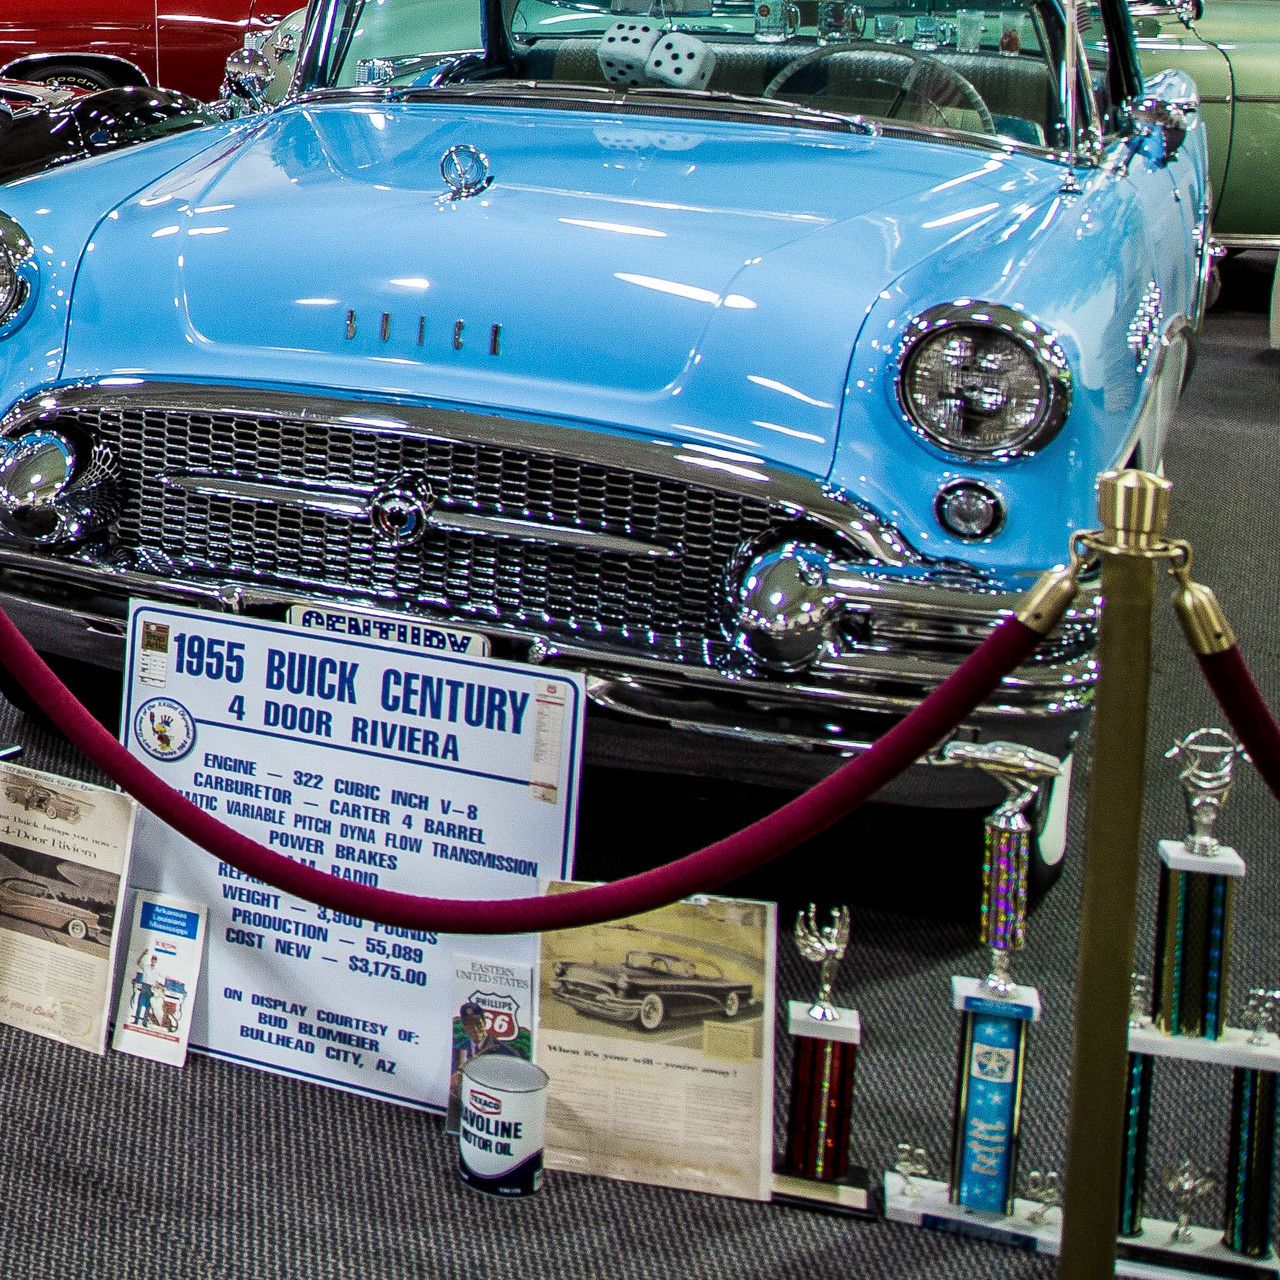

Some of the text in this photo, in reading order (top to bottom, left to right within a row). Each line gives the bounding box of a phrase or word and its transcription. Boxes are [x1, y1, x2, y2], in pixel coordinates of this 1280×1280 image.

[174, 632, 530, 735] 1955 BUICK CENTURY
[228, 694, 460, 762] 4 DOOR RIVIERA
[204, 752, 257, 776] ENGINE
[293, 770, 324, 790] 322
[334, 778, 380, 800] CUBIC
[391, 789, 430, 811] INCH
[13, 814, 40, 829] Buick
[193, 772, 486, 845] CARBURETOR CARTER 4 BARREL
[1, 824, 48, 845] 4-Door
[52, 838, 98, 859] Riviera
[226, 799, 538, 878] VARIABLE PITCH DYNA FLOW TRANSMISSION
[269, 830, 324, 856] POWER
[336, 844, 398, 871] BRAKES
[330, 864, 379, 888] RADIO
[222, 884, 281, 910] WEIGHT
[152, 915, 187, 928] Louisiana
[154, 906, 188, 918] Arkansas
[232, 908, 424, 964] PRODUCTION 55,089
[226, 927, 428, 986] COST NEW $3,175.00
[471, 962, 516, 978] EASTERN
[456, 970, 529, 990] UNITED STATES
[224, 987, 420, 1045] ON DISPLAY COURTESY OF:
[476, 996, 513, 1012] PHILLIPS
[258, 1012, 288, 1030] BUD
[483, 1012, 509, 1034] 66
[240, 1024, 397, 1075] BULLHEAD CITY, AZ
[548, 1044, 580, 1056] When
[471, 1096, 501, 1110] TEXACO
[463, 1107, 523, 1139] AVOLINE
[462, 1128, 514, 1157] MOTOR OIL
